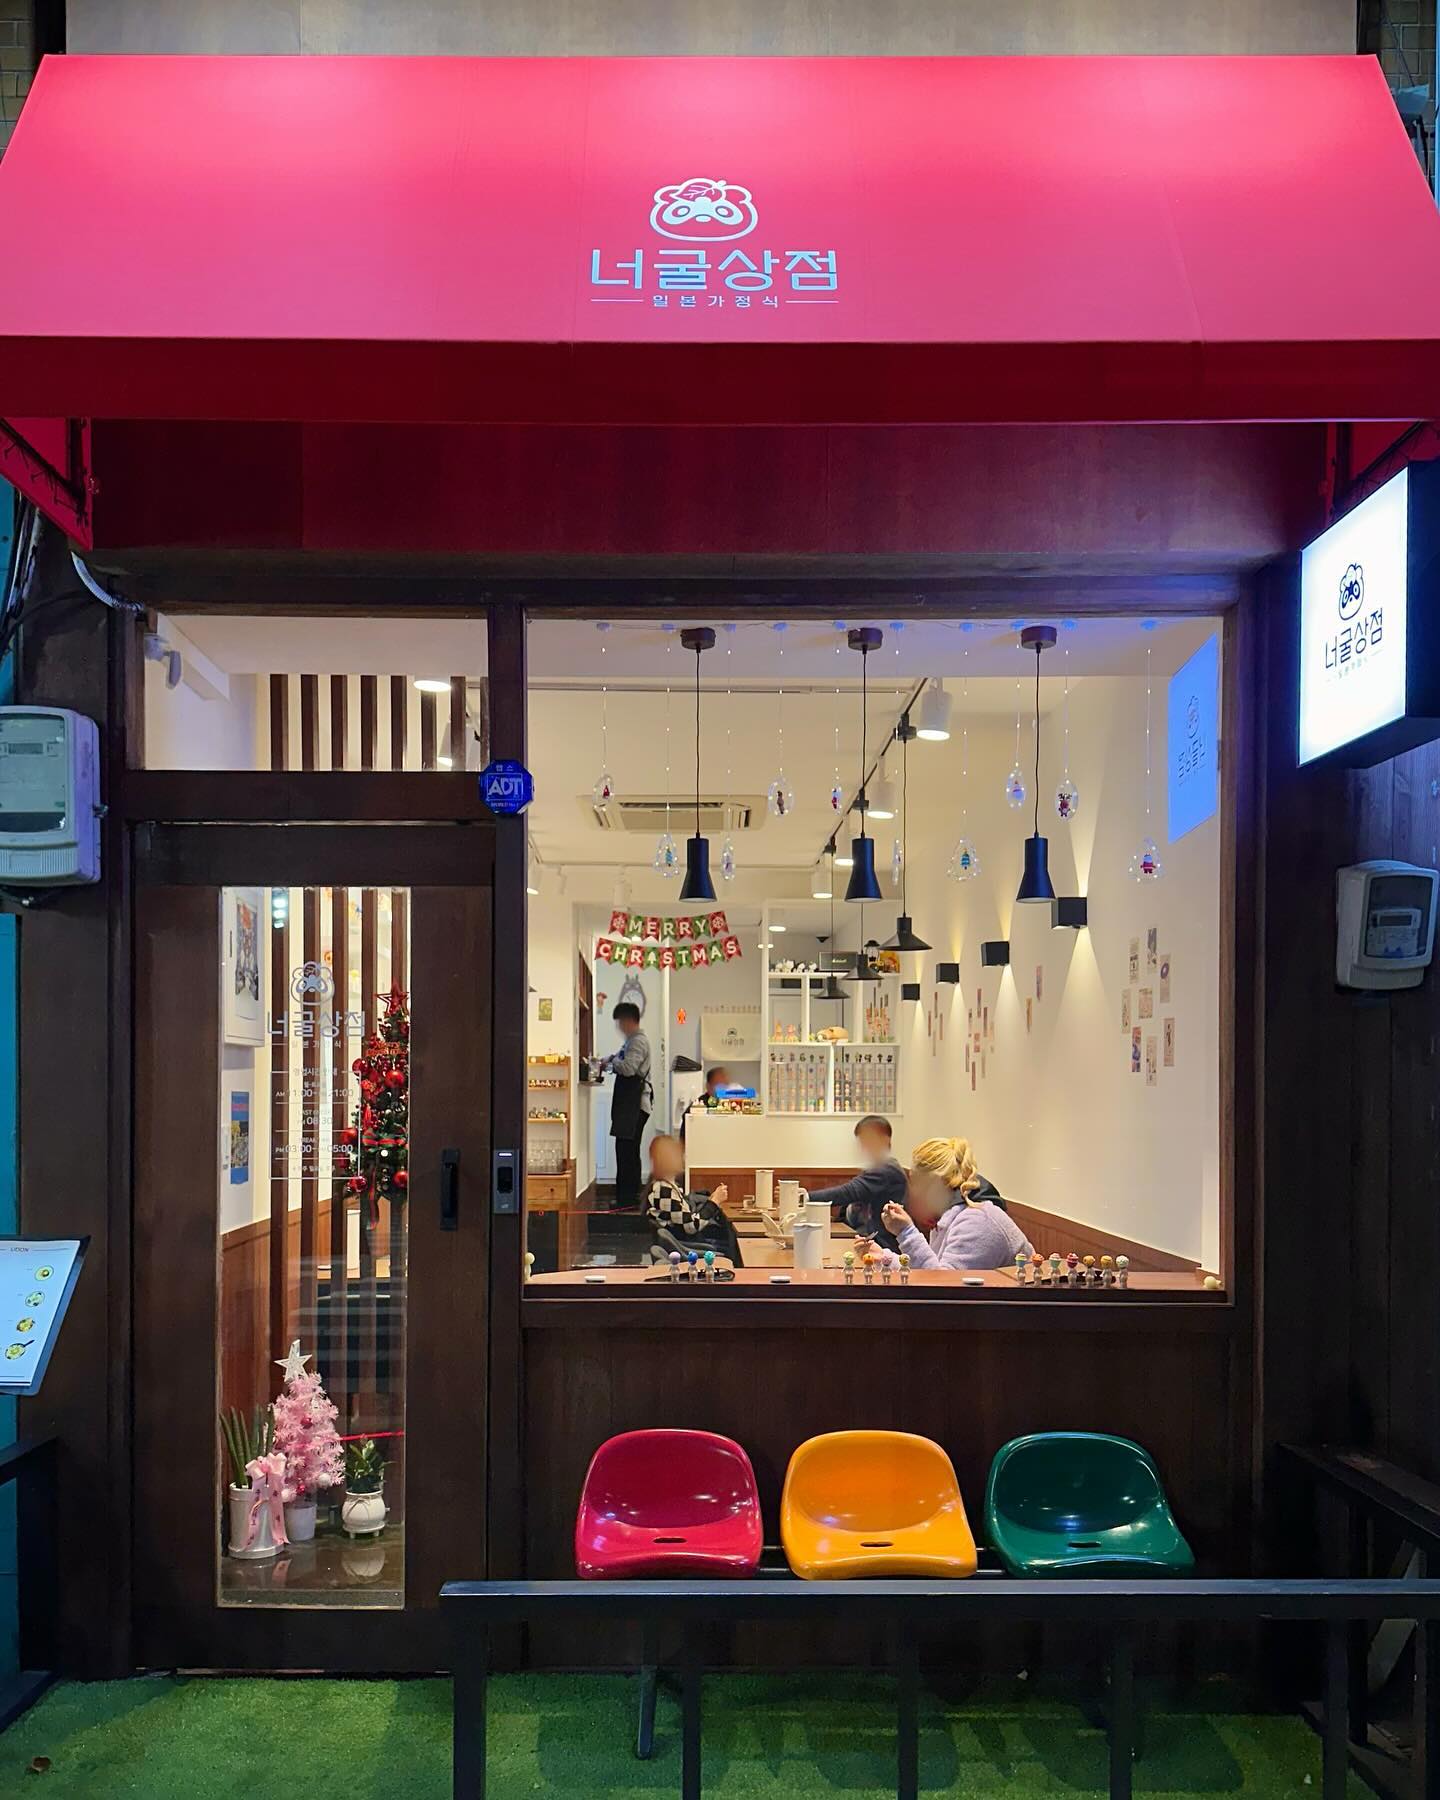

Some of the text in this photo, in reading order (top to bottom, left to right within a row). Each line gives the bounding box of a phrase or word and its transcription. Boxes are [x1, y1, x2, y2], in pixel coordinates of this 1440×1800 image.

[591, 248, 838, 291] 너굴상점
[1325, 607, 1383, 669] 너굴상점
[488, 776, 522, 796] ADT
[629, 919, 707, 936] MERRY
[267, 1011, 365, 1037] 너굴상점
